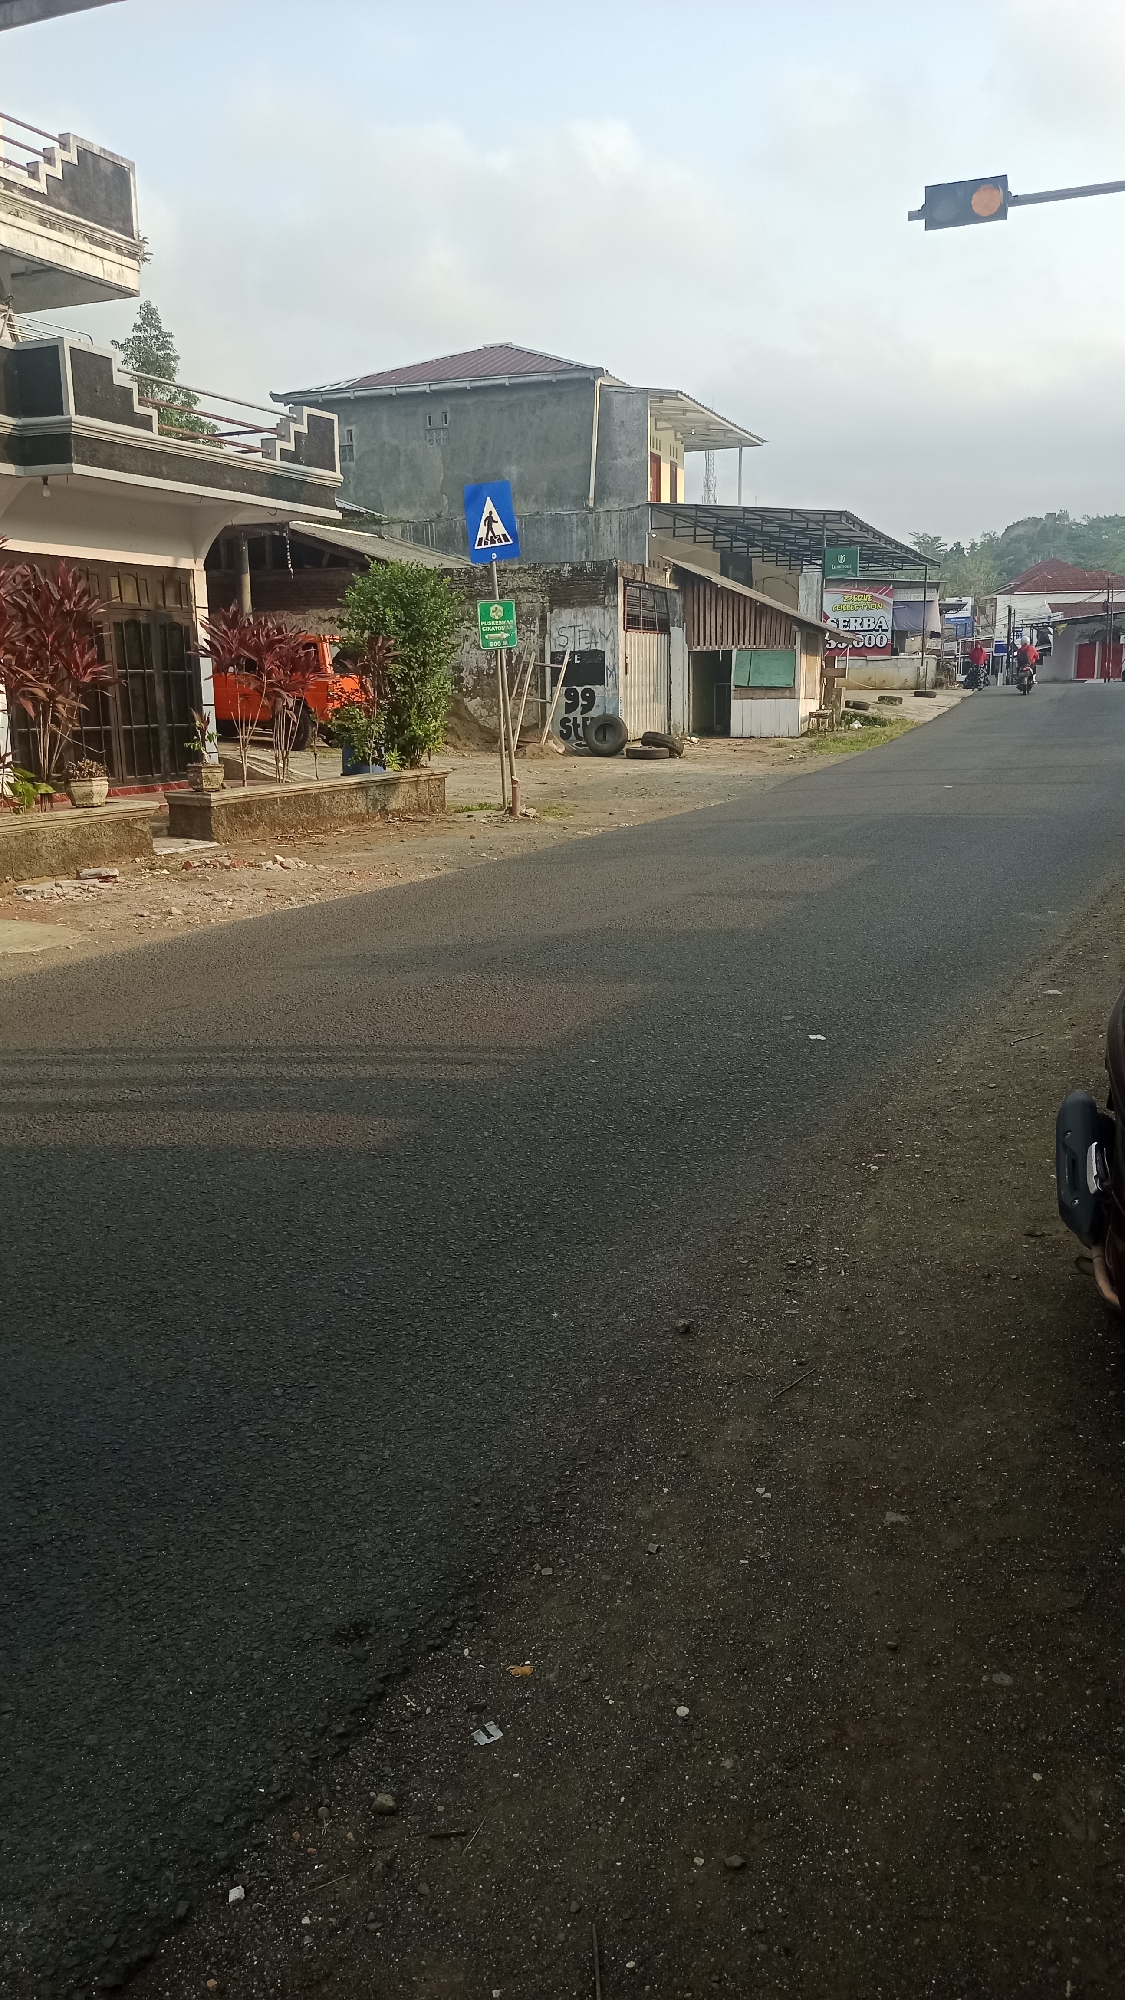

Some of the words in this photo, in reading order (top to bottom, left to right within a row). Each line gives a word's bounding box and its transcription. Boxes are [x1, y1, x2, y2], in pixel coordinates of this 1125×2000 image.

[832, 602, 884, 612] COLLECTION
[827, 616, 889, 631] SERBA
[564, 687, 597, 716] 99
